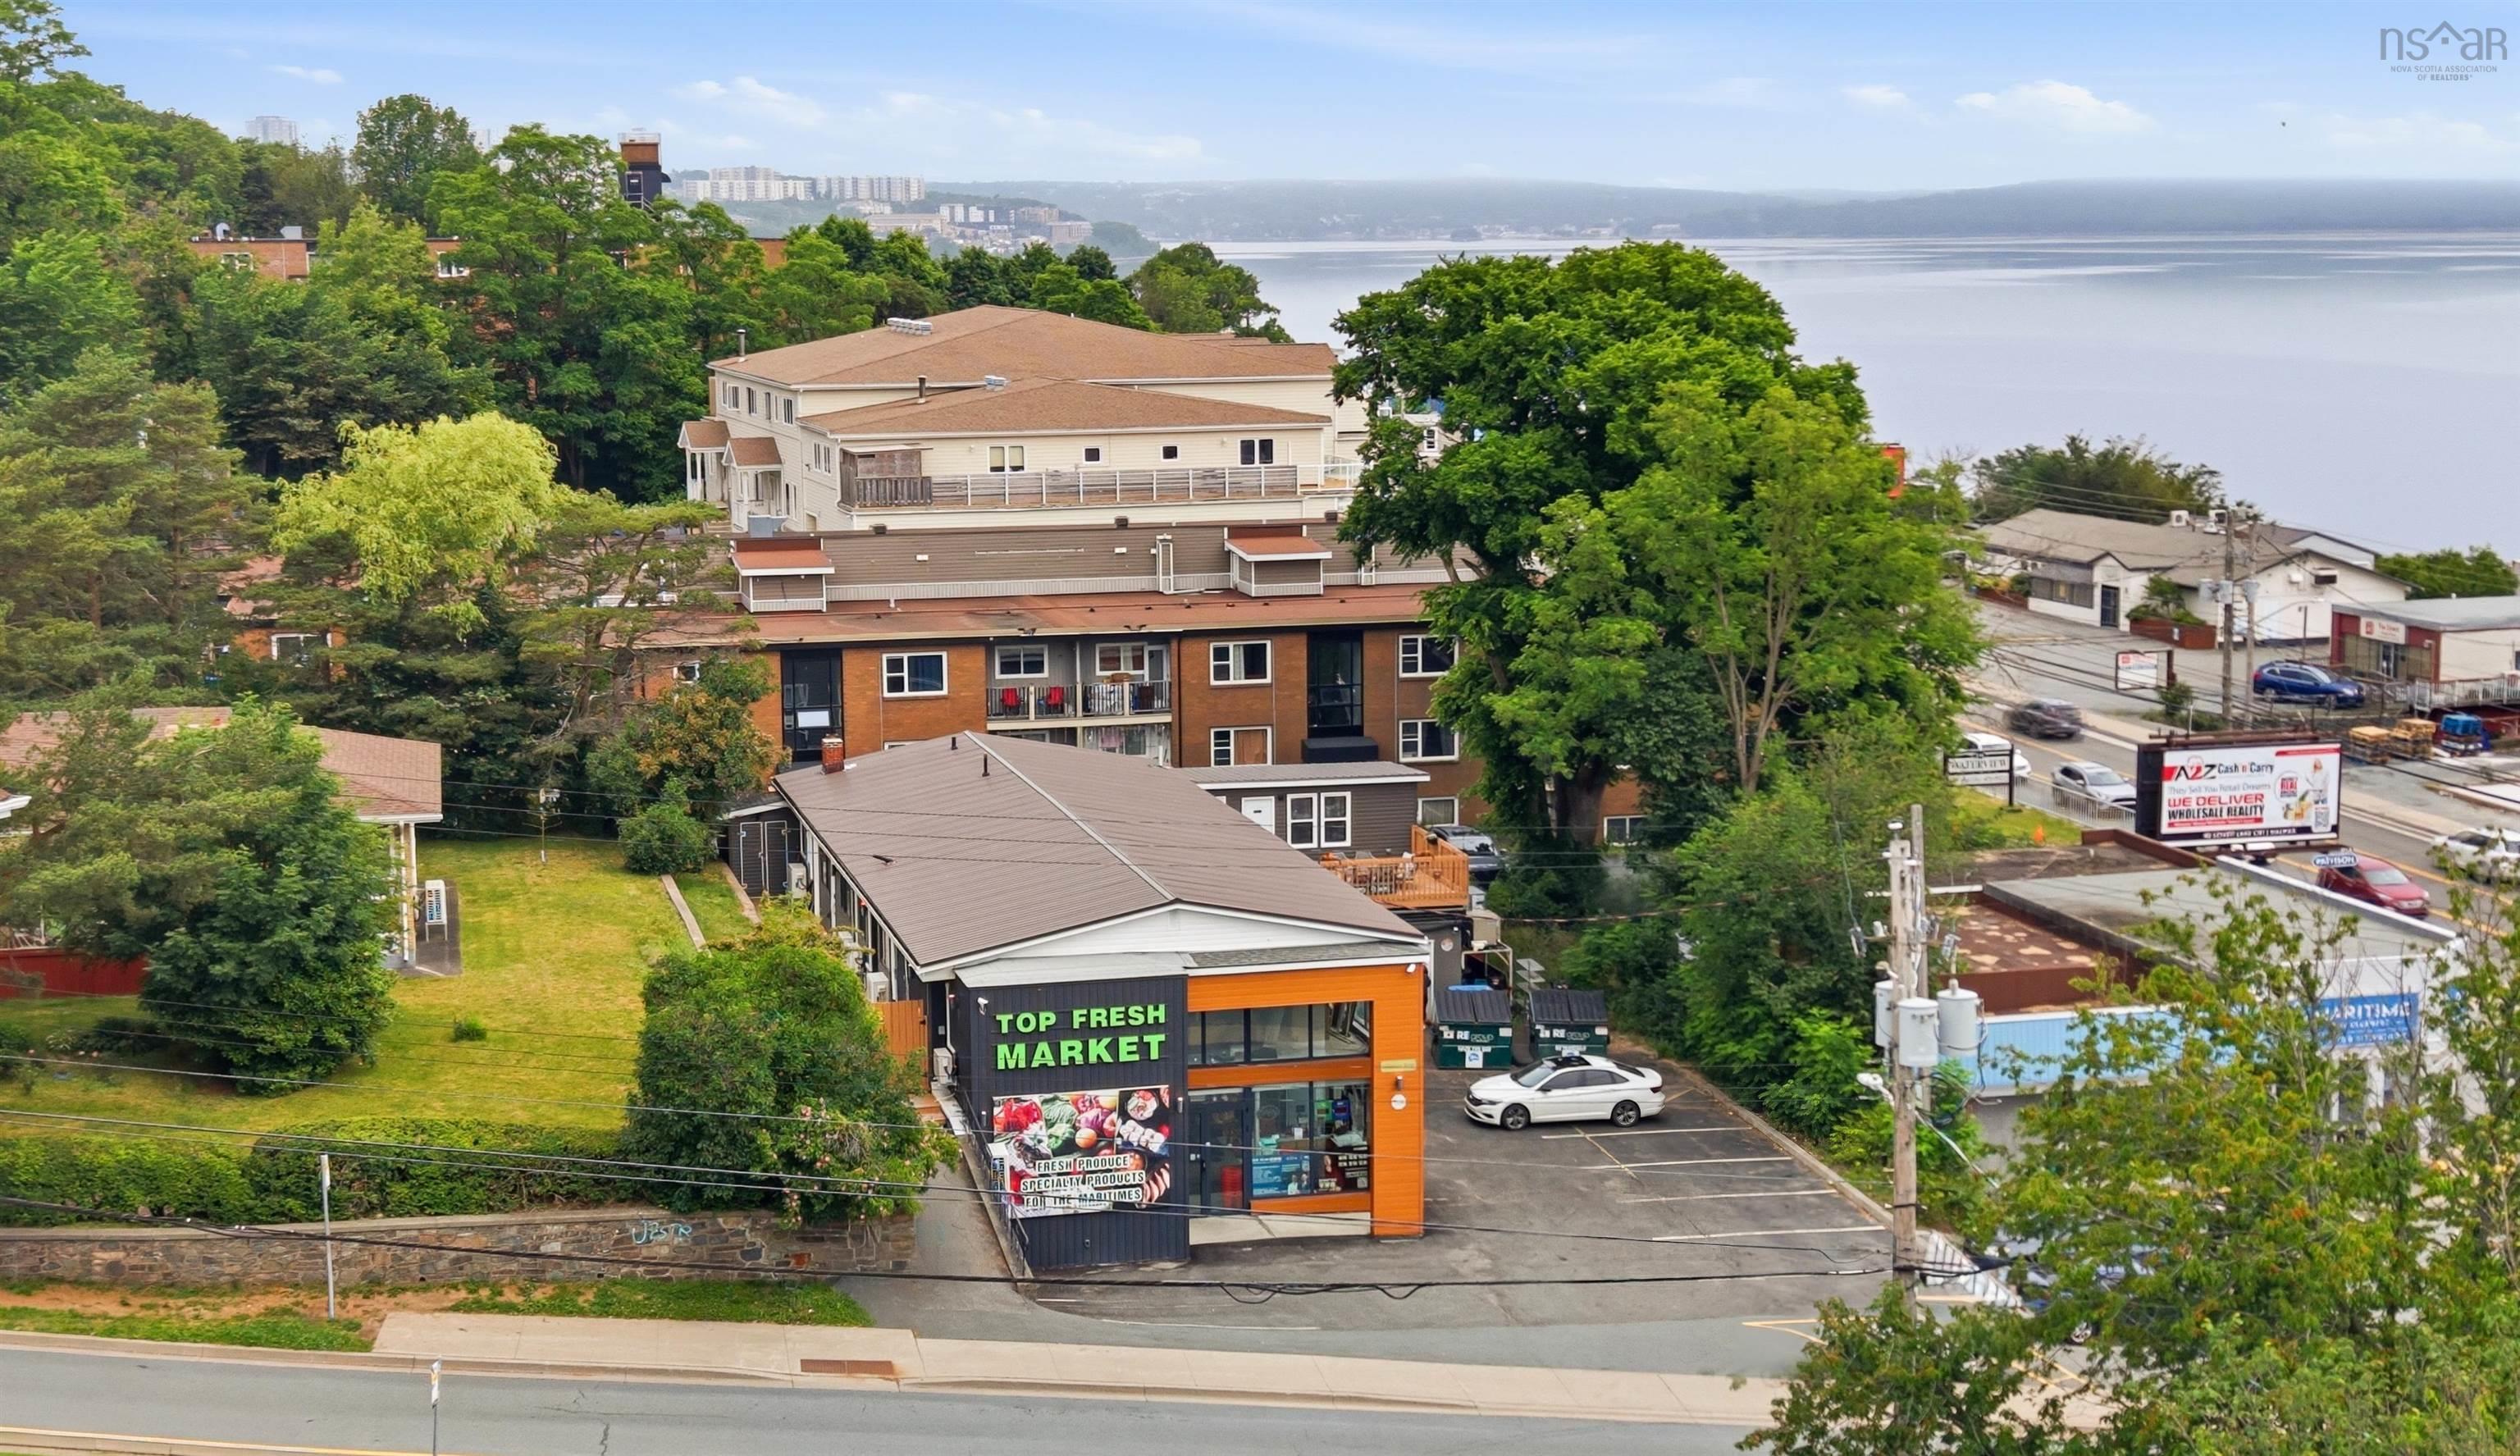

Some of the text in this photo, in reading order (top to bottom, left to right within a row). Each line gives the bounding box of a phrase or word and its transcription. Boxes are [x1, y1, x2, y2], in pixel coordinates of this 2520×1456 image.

[2217, 763, 2239, 774] Cash
[2249, 761, 2274, 774] Carry
[2168, 793, 2264, 807] WE DELIVER
[2168, 804, 2264, 820] WHOLESALE REALITY
[996, 1003, 1166, 1034] TOP FRESH
[997, 1034, 1166, 1070] MARKET
[1038, 1156, 1129, 1172] FRESH PRODUCE
[1022, 1171, 1144, 1191] SPECIALTY PRODUCTS
[1026, 1189, 1142, 1209] FOR THE MARITIMES
